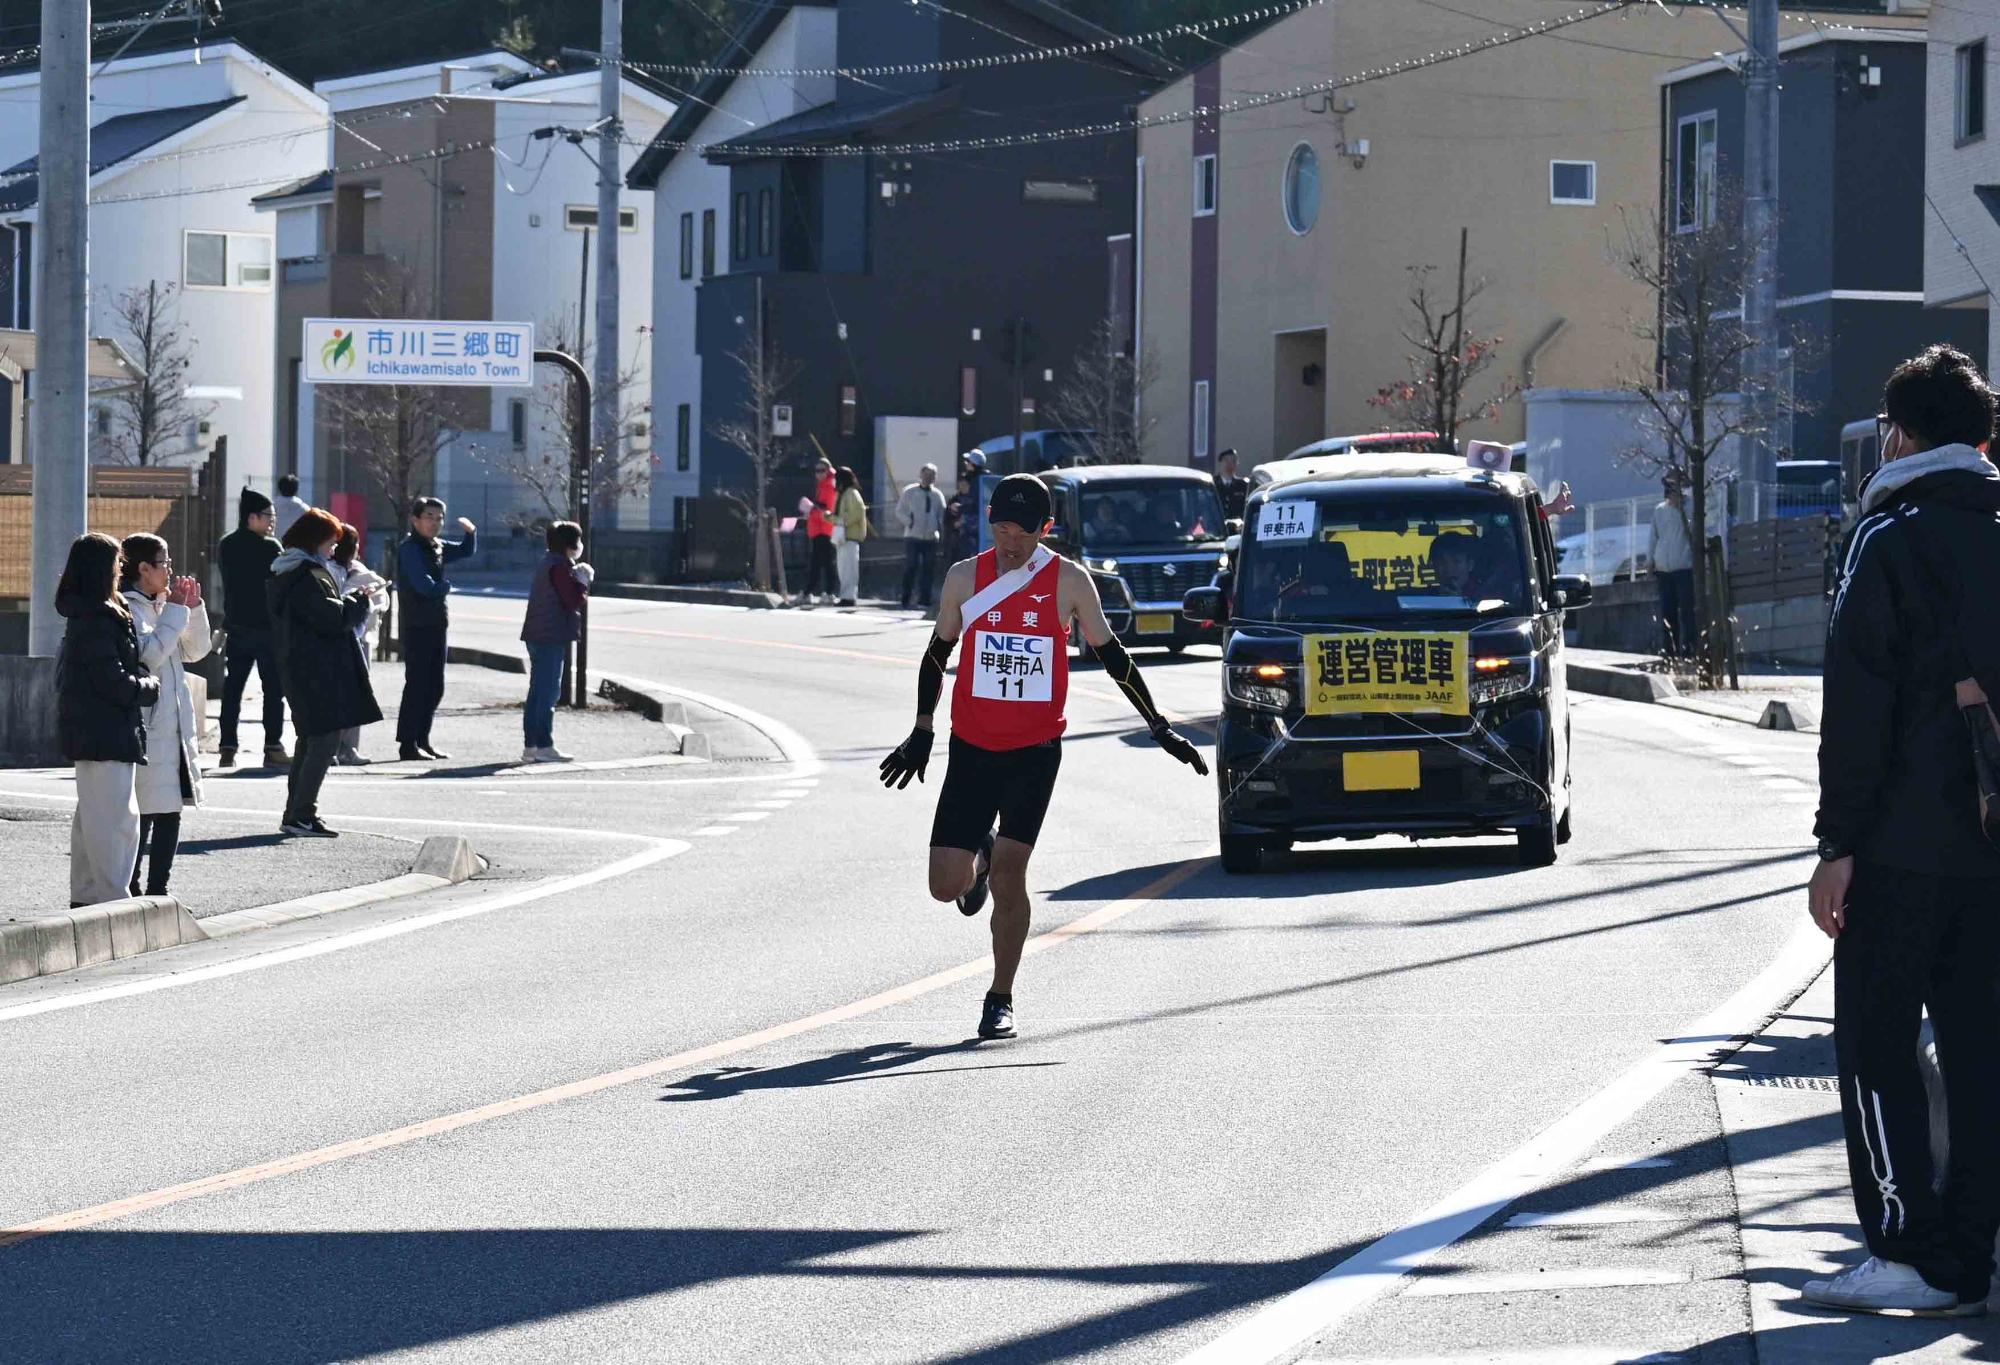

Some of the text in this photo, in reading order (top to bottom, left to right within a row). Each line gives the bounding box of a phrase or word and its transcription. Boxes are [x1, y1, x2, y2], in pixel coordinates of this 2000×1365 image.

[367, 329, 521, 358] 市川三郷町
[367, 360, 520, 376] Ichikawamisato Town
[1276, 505, 1295, 521] 11
[1263, 521, 1305, 537] 甲斐市A
[985, 635, 1043, 655] NEC
[981, 652, 1044, 676] 甲斐市A
[1317, 637, 1454, 687] 運営管理車
[998, 677, 1024, 699] 11
[1425, 690, 1453, 701] JAAF
